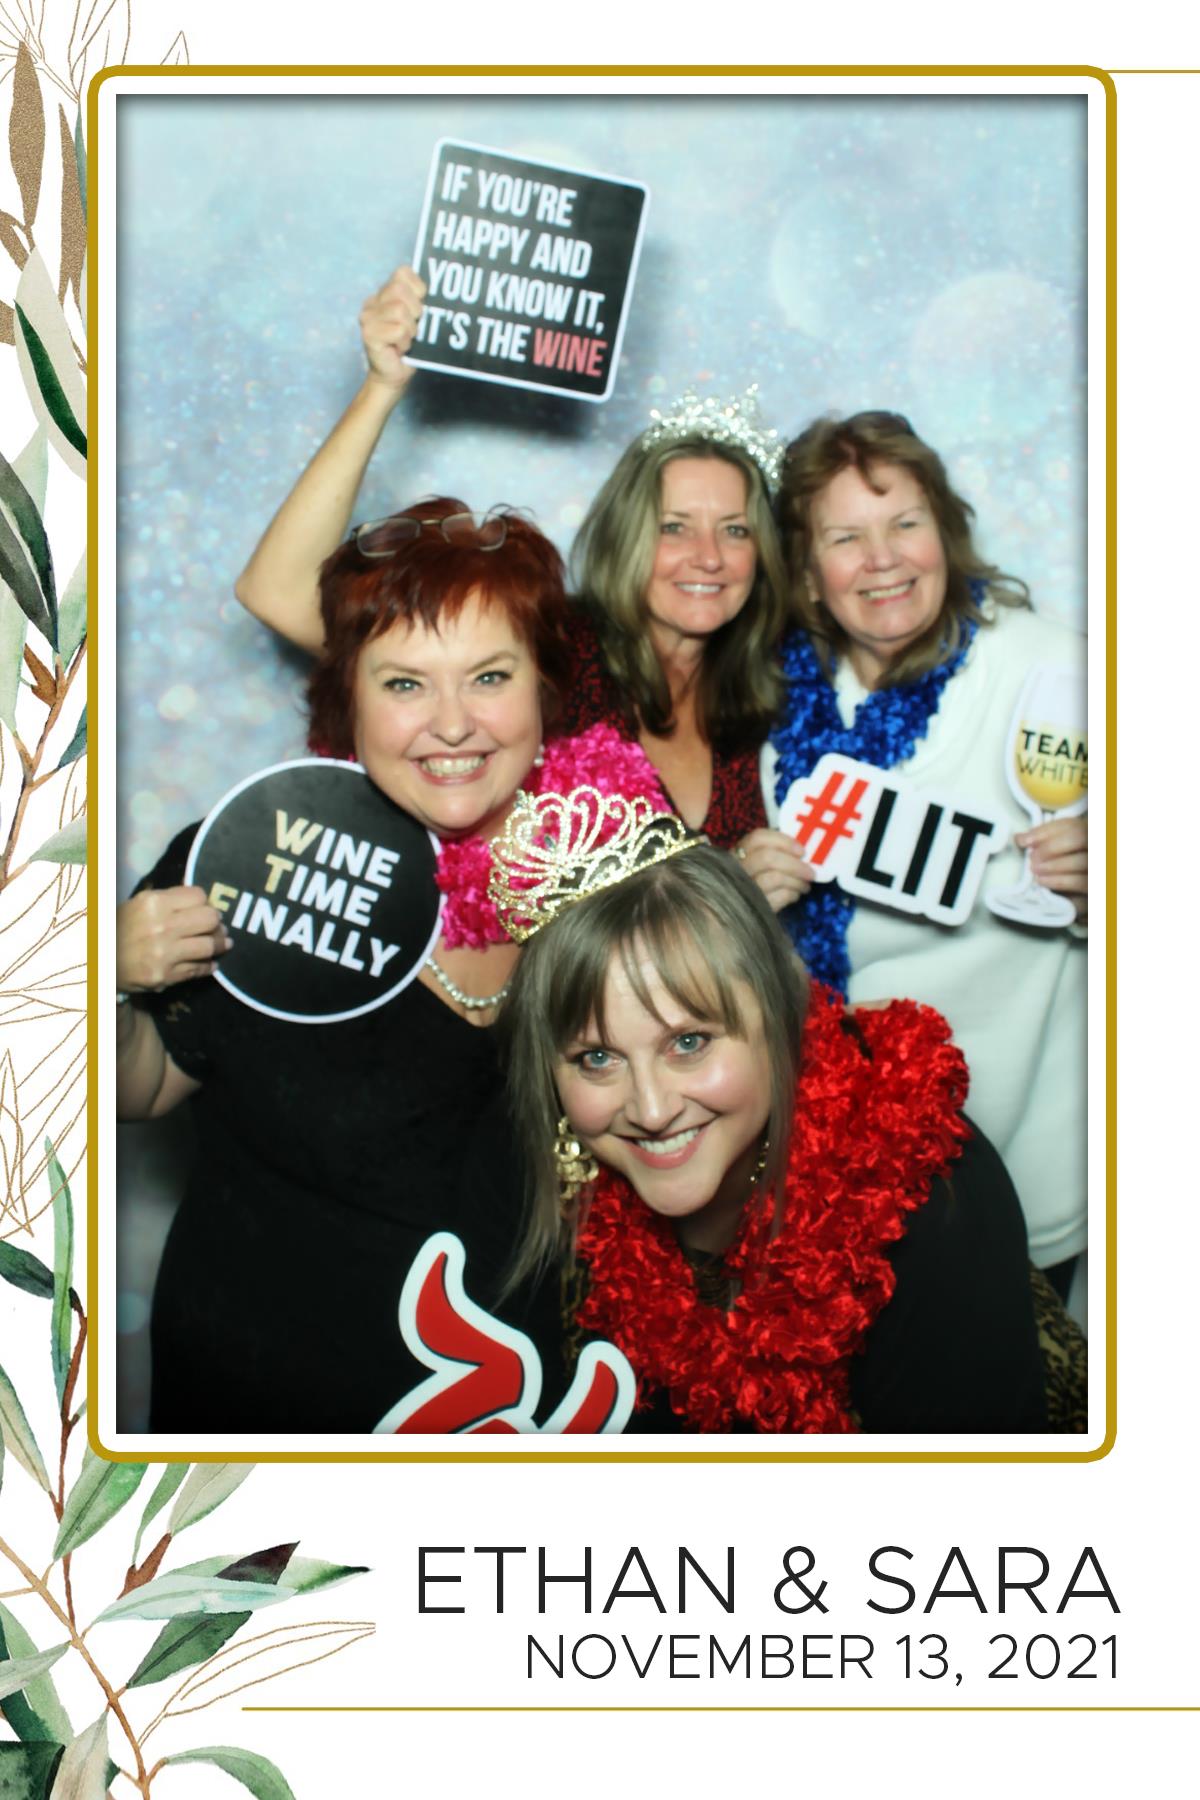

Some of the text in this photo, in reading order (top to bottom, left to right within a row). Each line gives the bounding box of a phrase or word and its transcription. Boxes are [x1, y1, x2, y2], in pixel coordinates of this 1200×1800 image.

[441, 162, 577, 227] IF YOU'RE
[432, 210, 592, 278] HAPPY AND
[427, 257, 605, 335] YOU KNOW IT,
[416, 304, 607, 377] IT'S THE WINE
[1017, 753, 1088, 788] WHITE
[275, 809, 400, 888] WINE
[795, 771, 994, 909] #LIT
[264, 853, 379, 927] TIME
